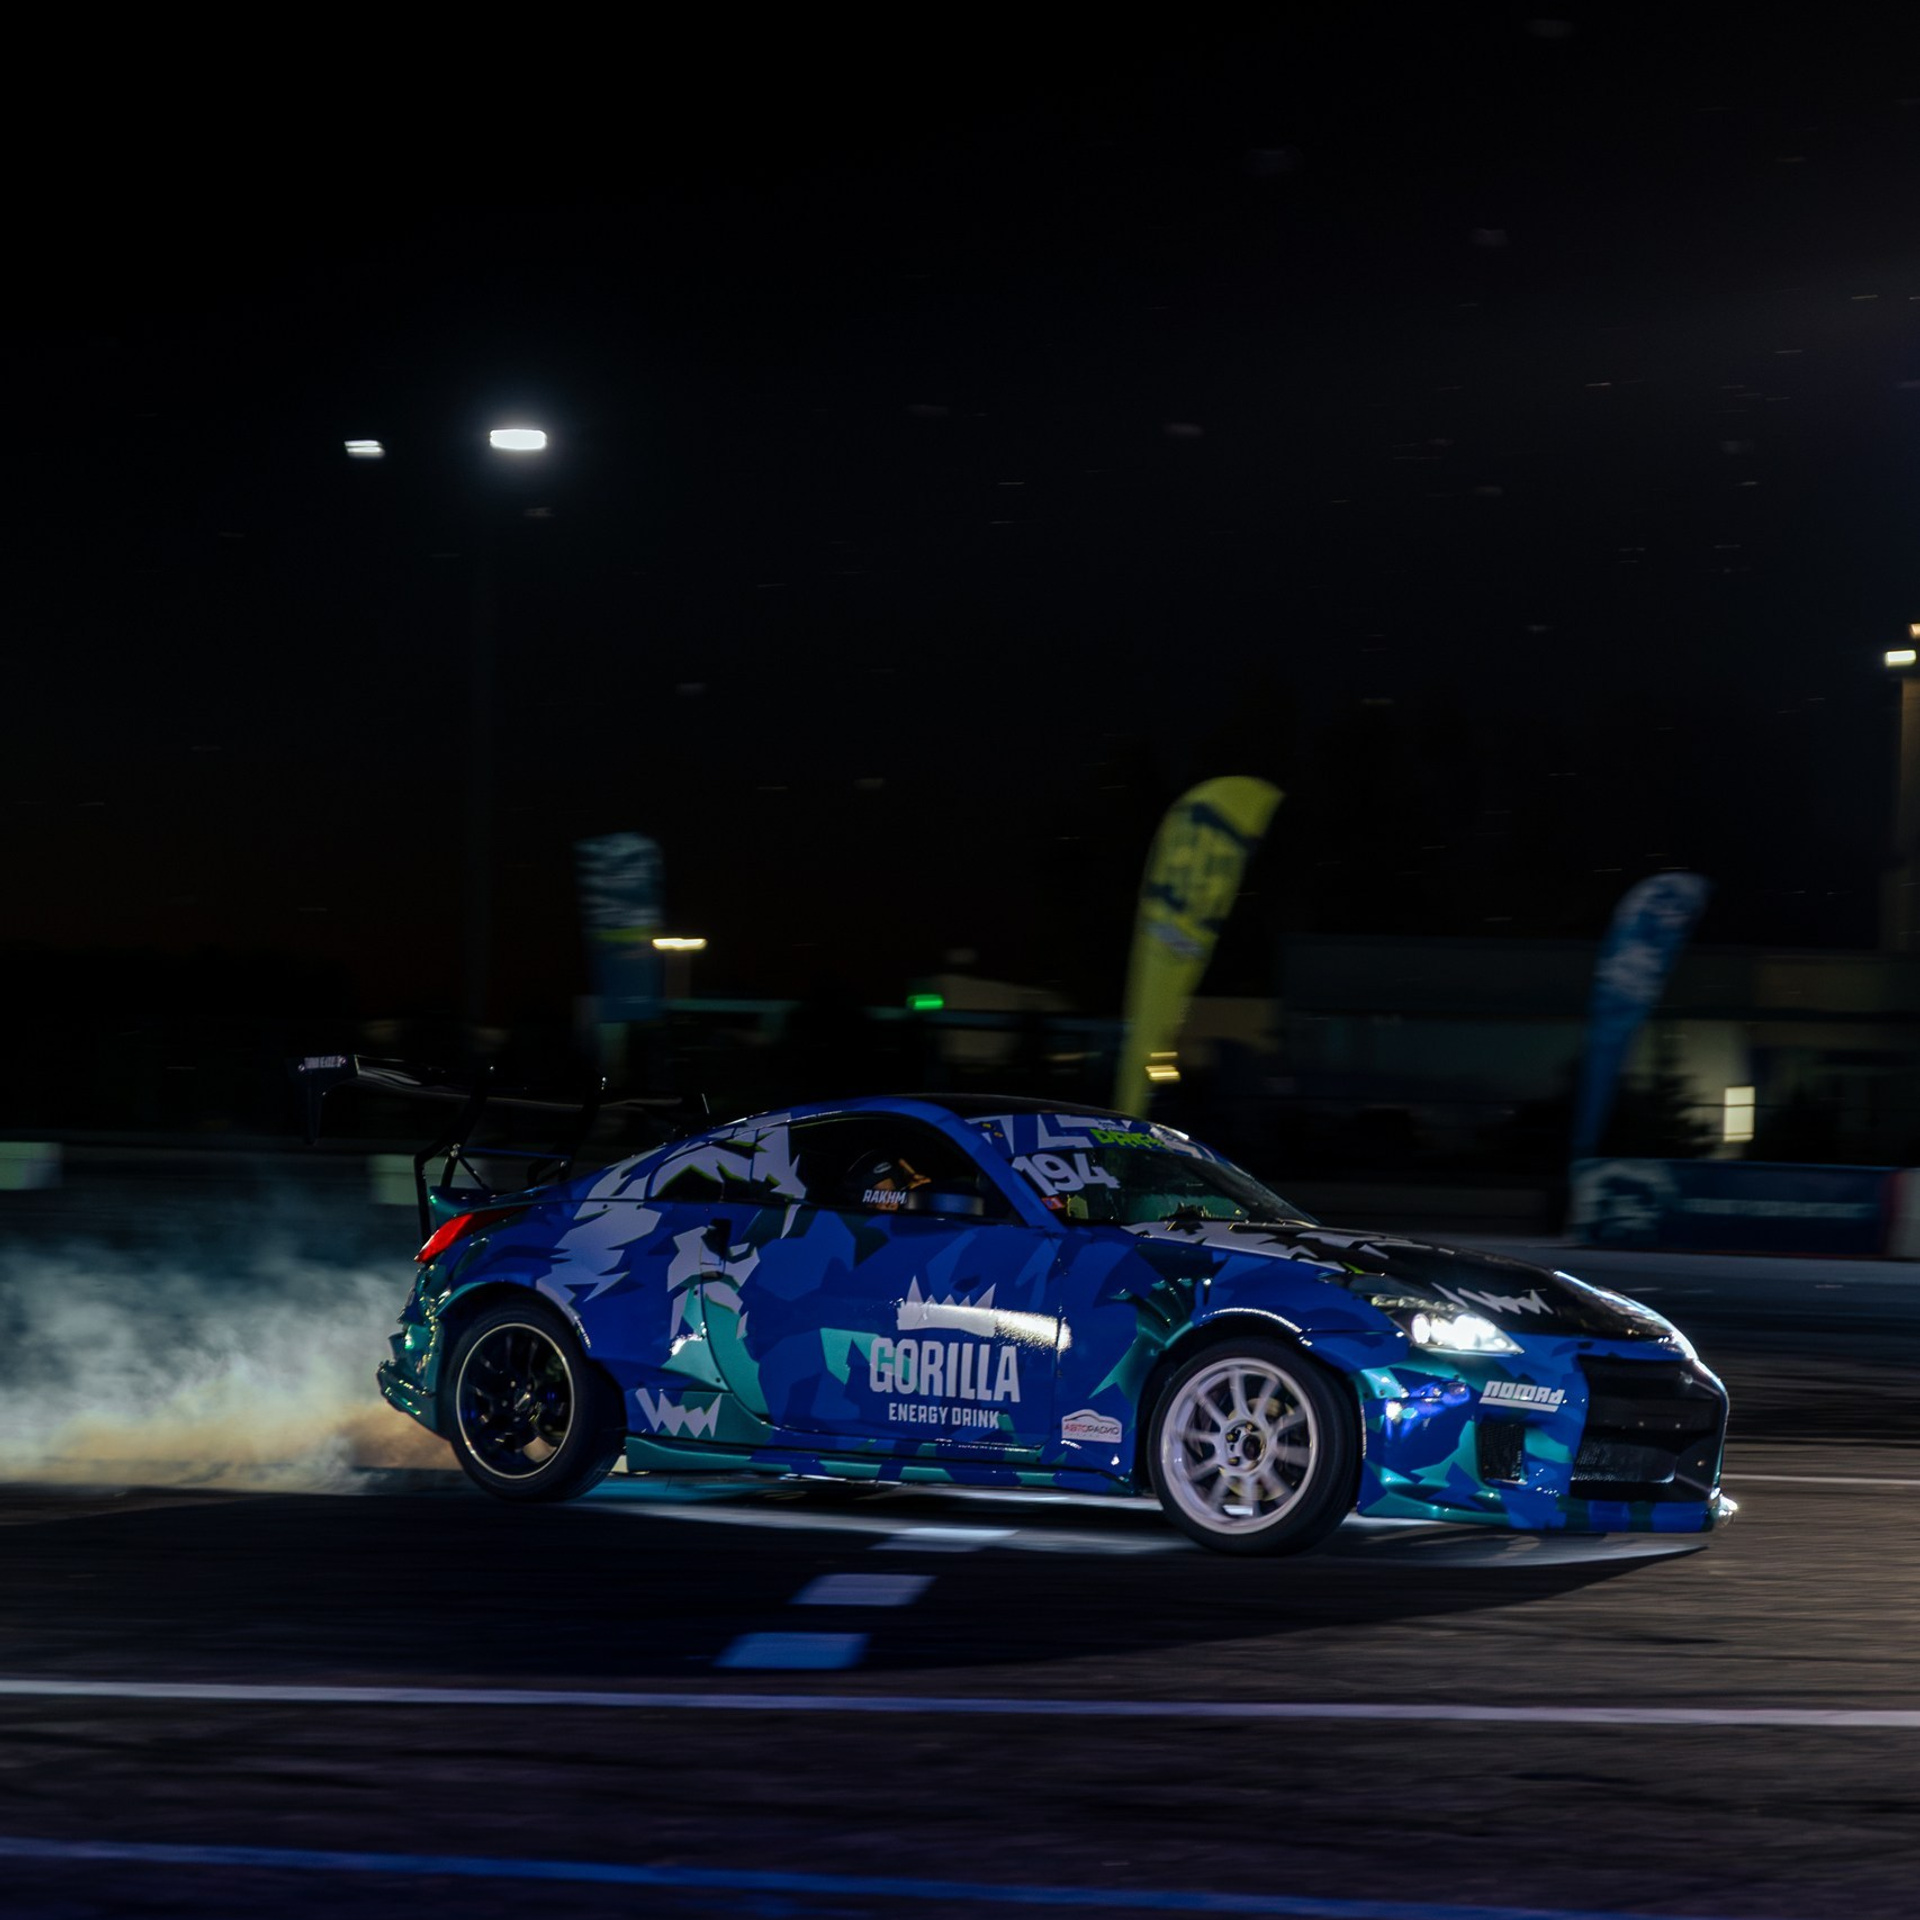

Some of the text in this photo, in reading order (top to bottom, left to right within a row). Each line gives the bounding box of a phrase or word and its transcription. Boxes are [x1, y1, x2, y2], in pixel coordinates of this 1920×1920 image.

[1012, 1153, 1121, 1196] 194
[868, 1337, 1022, 1404] GORILLA
[888, 1402, 1000, 1429] ENERGY DRINK
